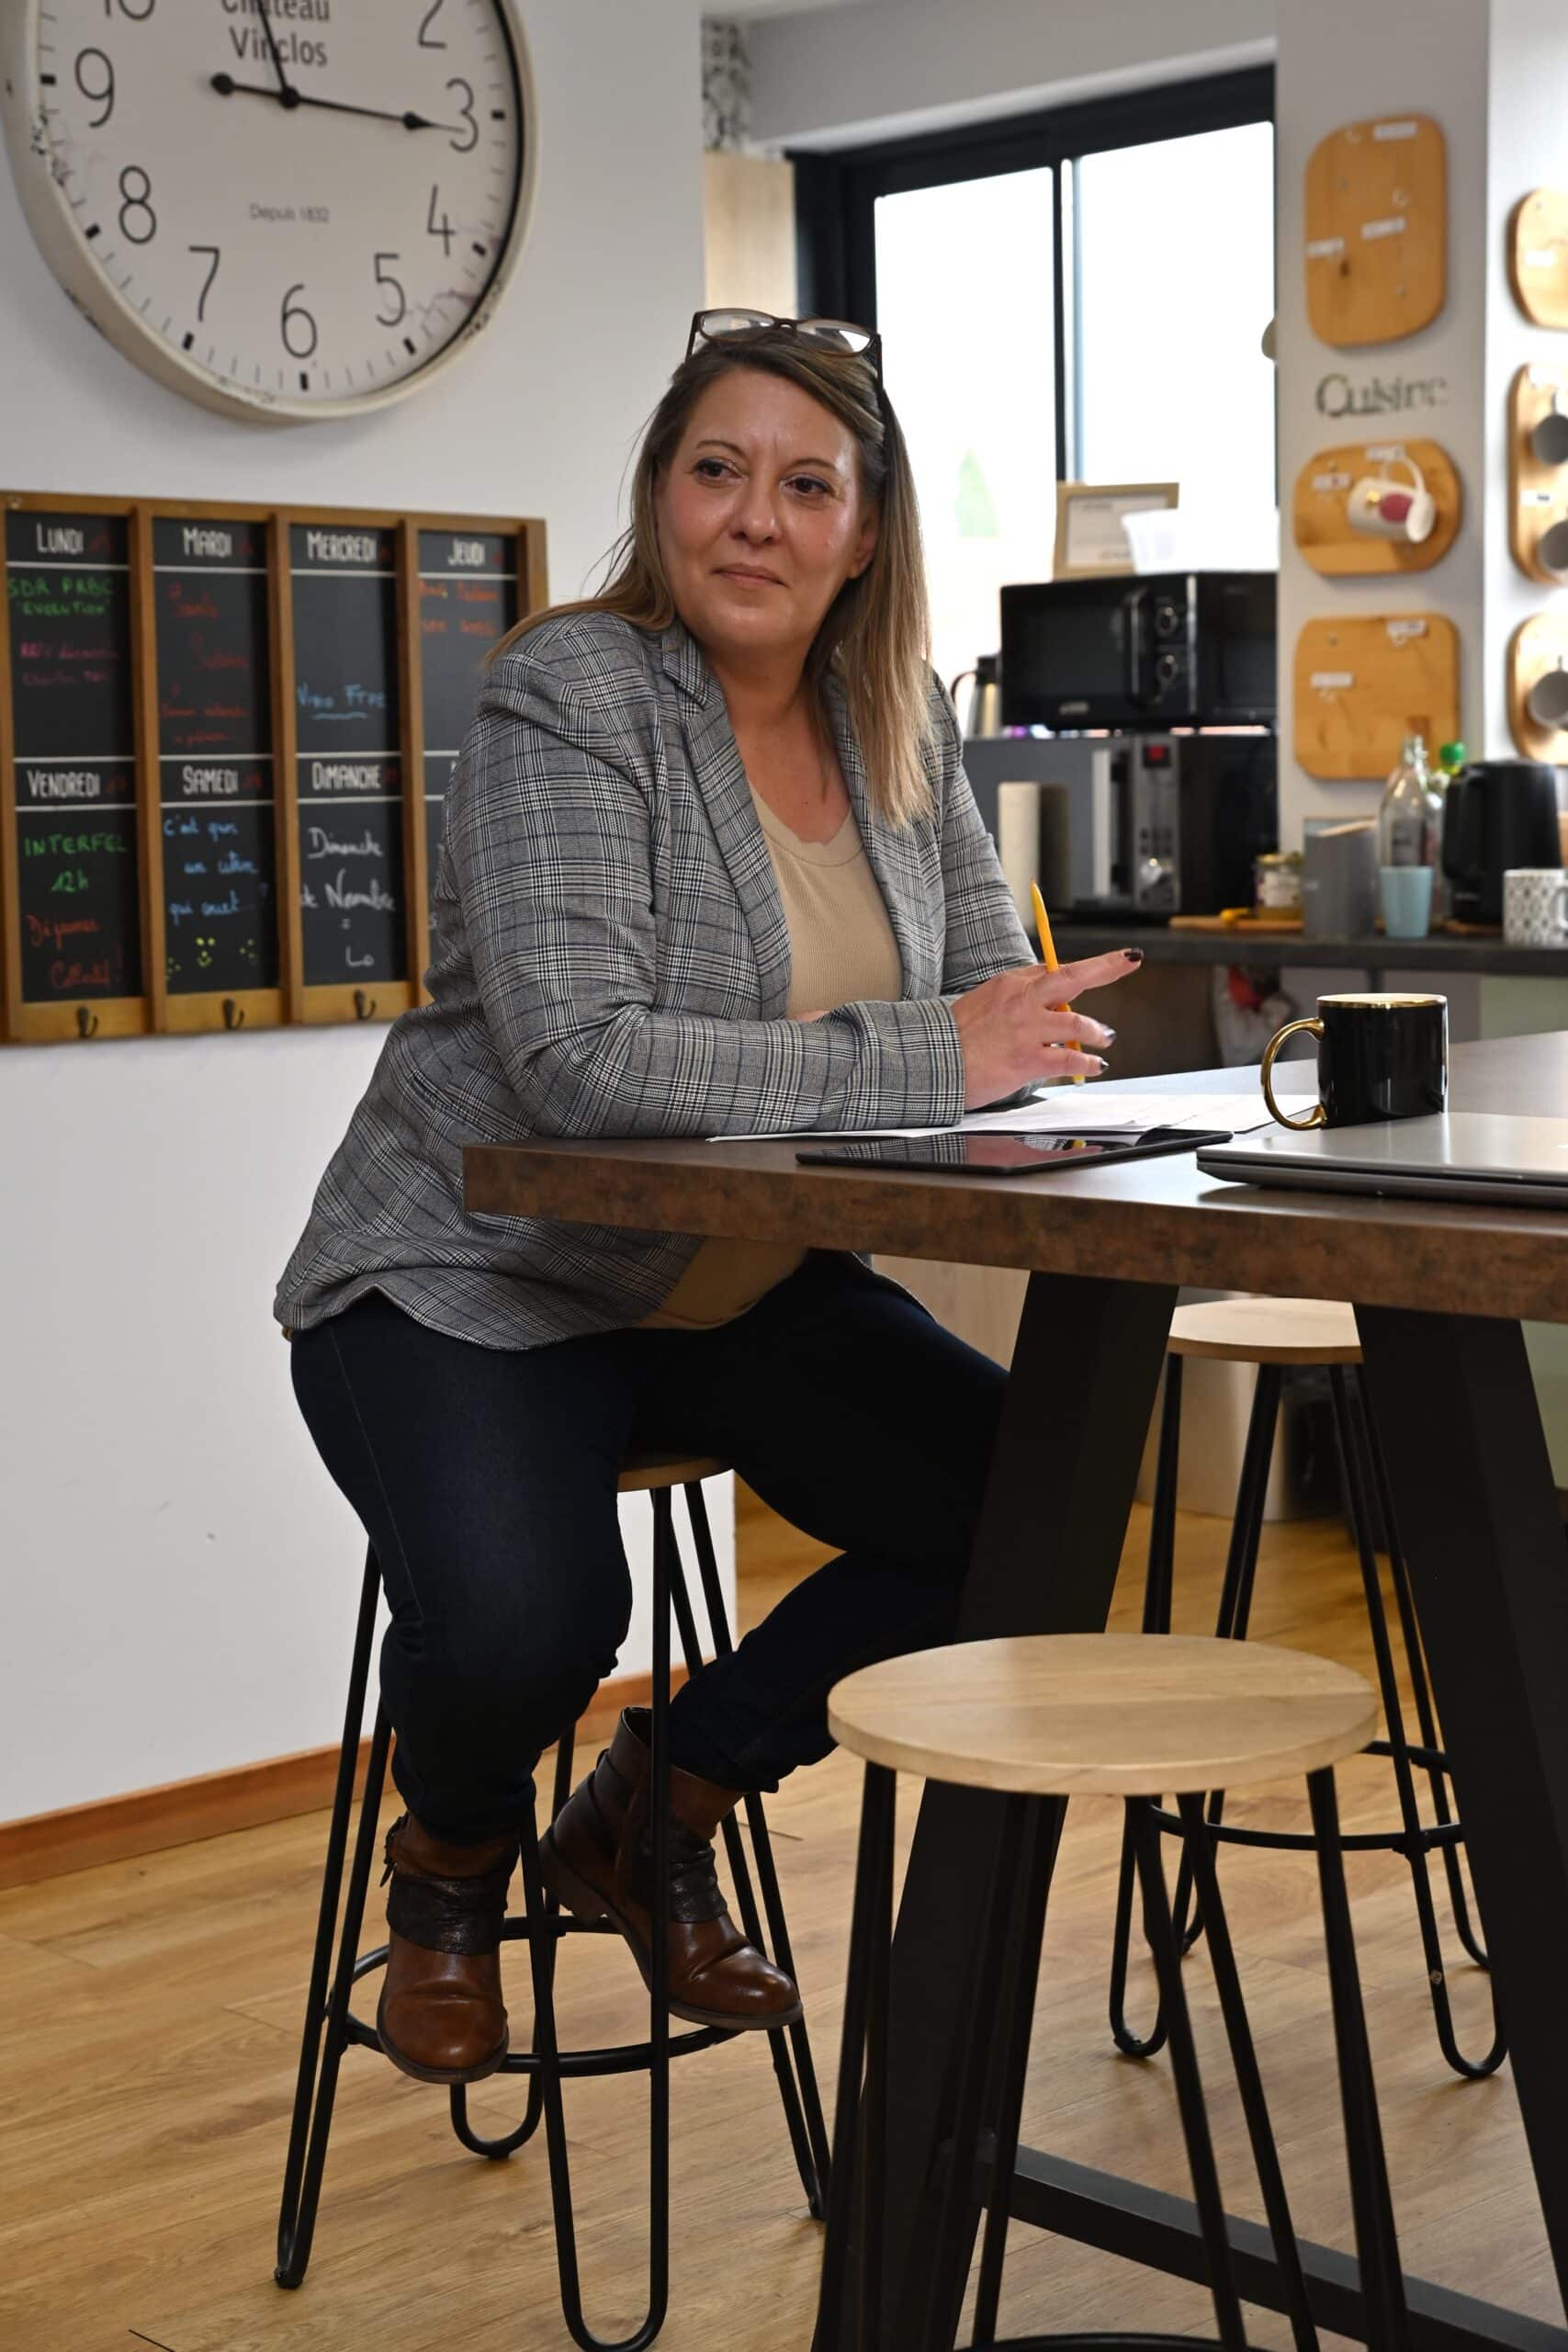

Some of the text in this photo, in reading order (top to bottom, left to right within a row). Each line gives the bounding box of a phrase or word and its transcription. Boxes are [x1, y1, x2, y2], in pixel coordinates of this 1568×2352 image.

[74, 48, 115, 128] 9
[446, 78, 479, 153] 3
[118, 165, 157, 244] 8
[426, 185, 456, 256] 4
[188, 246, 220, 322] 7
[281, 283, 318, 359] 6
[373, 253, 406, 327] 5
[25, 832, 129, 857] INTERFEL
